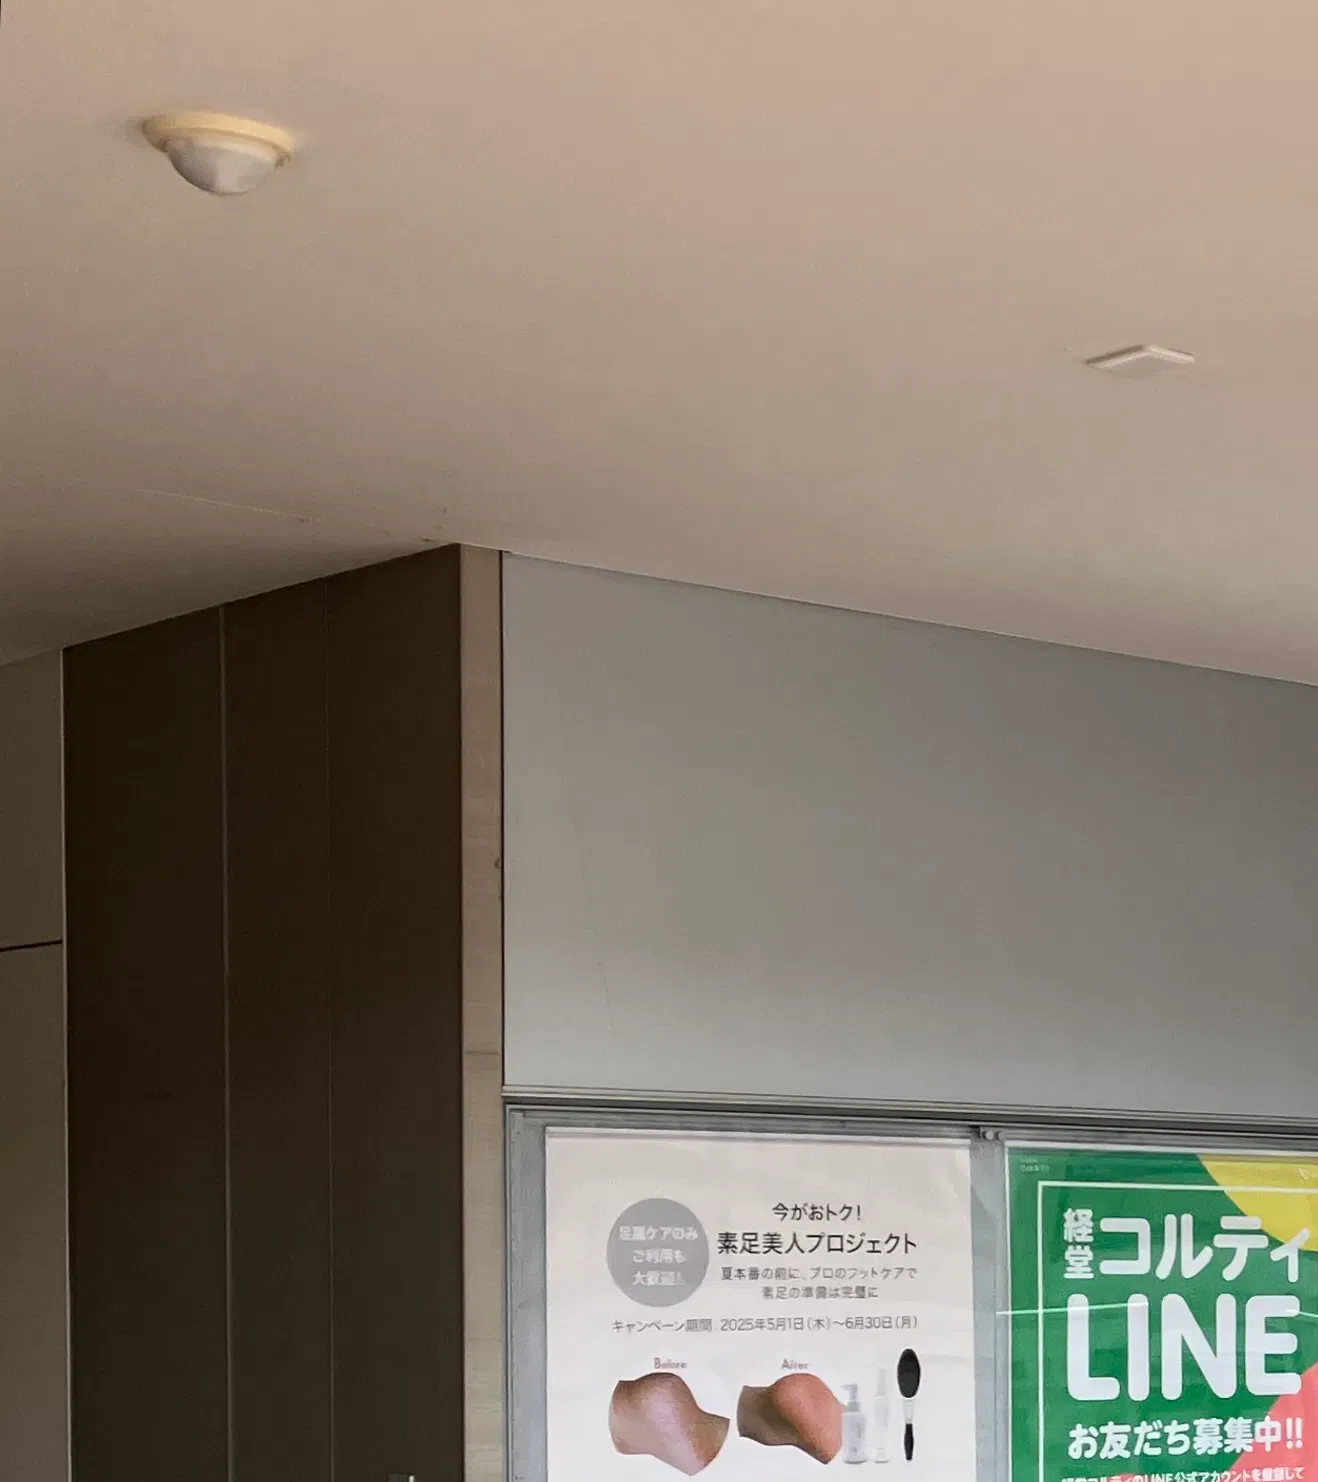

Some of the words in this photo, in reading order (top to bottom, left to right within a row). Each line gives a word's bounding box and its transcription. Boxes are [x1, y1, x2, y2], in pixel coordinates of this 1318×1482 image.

[772, 1202, 862, 1222] 今がおトク!
[717, 1231, 918, 1256] 素足美人プロジェクト
[1063, 1207, 1095, 1279] 経堂
[1099, 1212, 1312, 1283] コルティ
[1066, 1293, 1302, 1401] LINE
[1067, 1416, 1304, 1461] お友だち募集中!!
